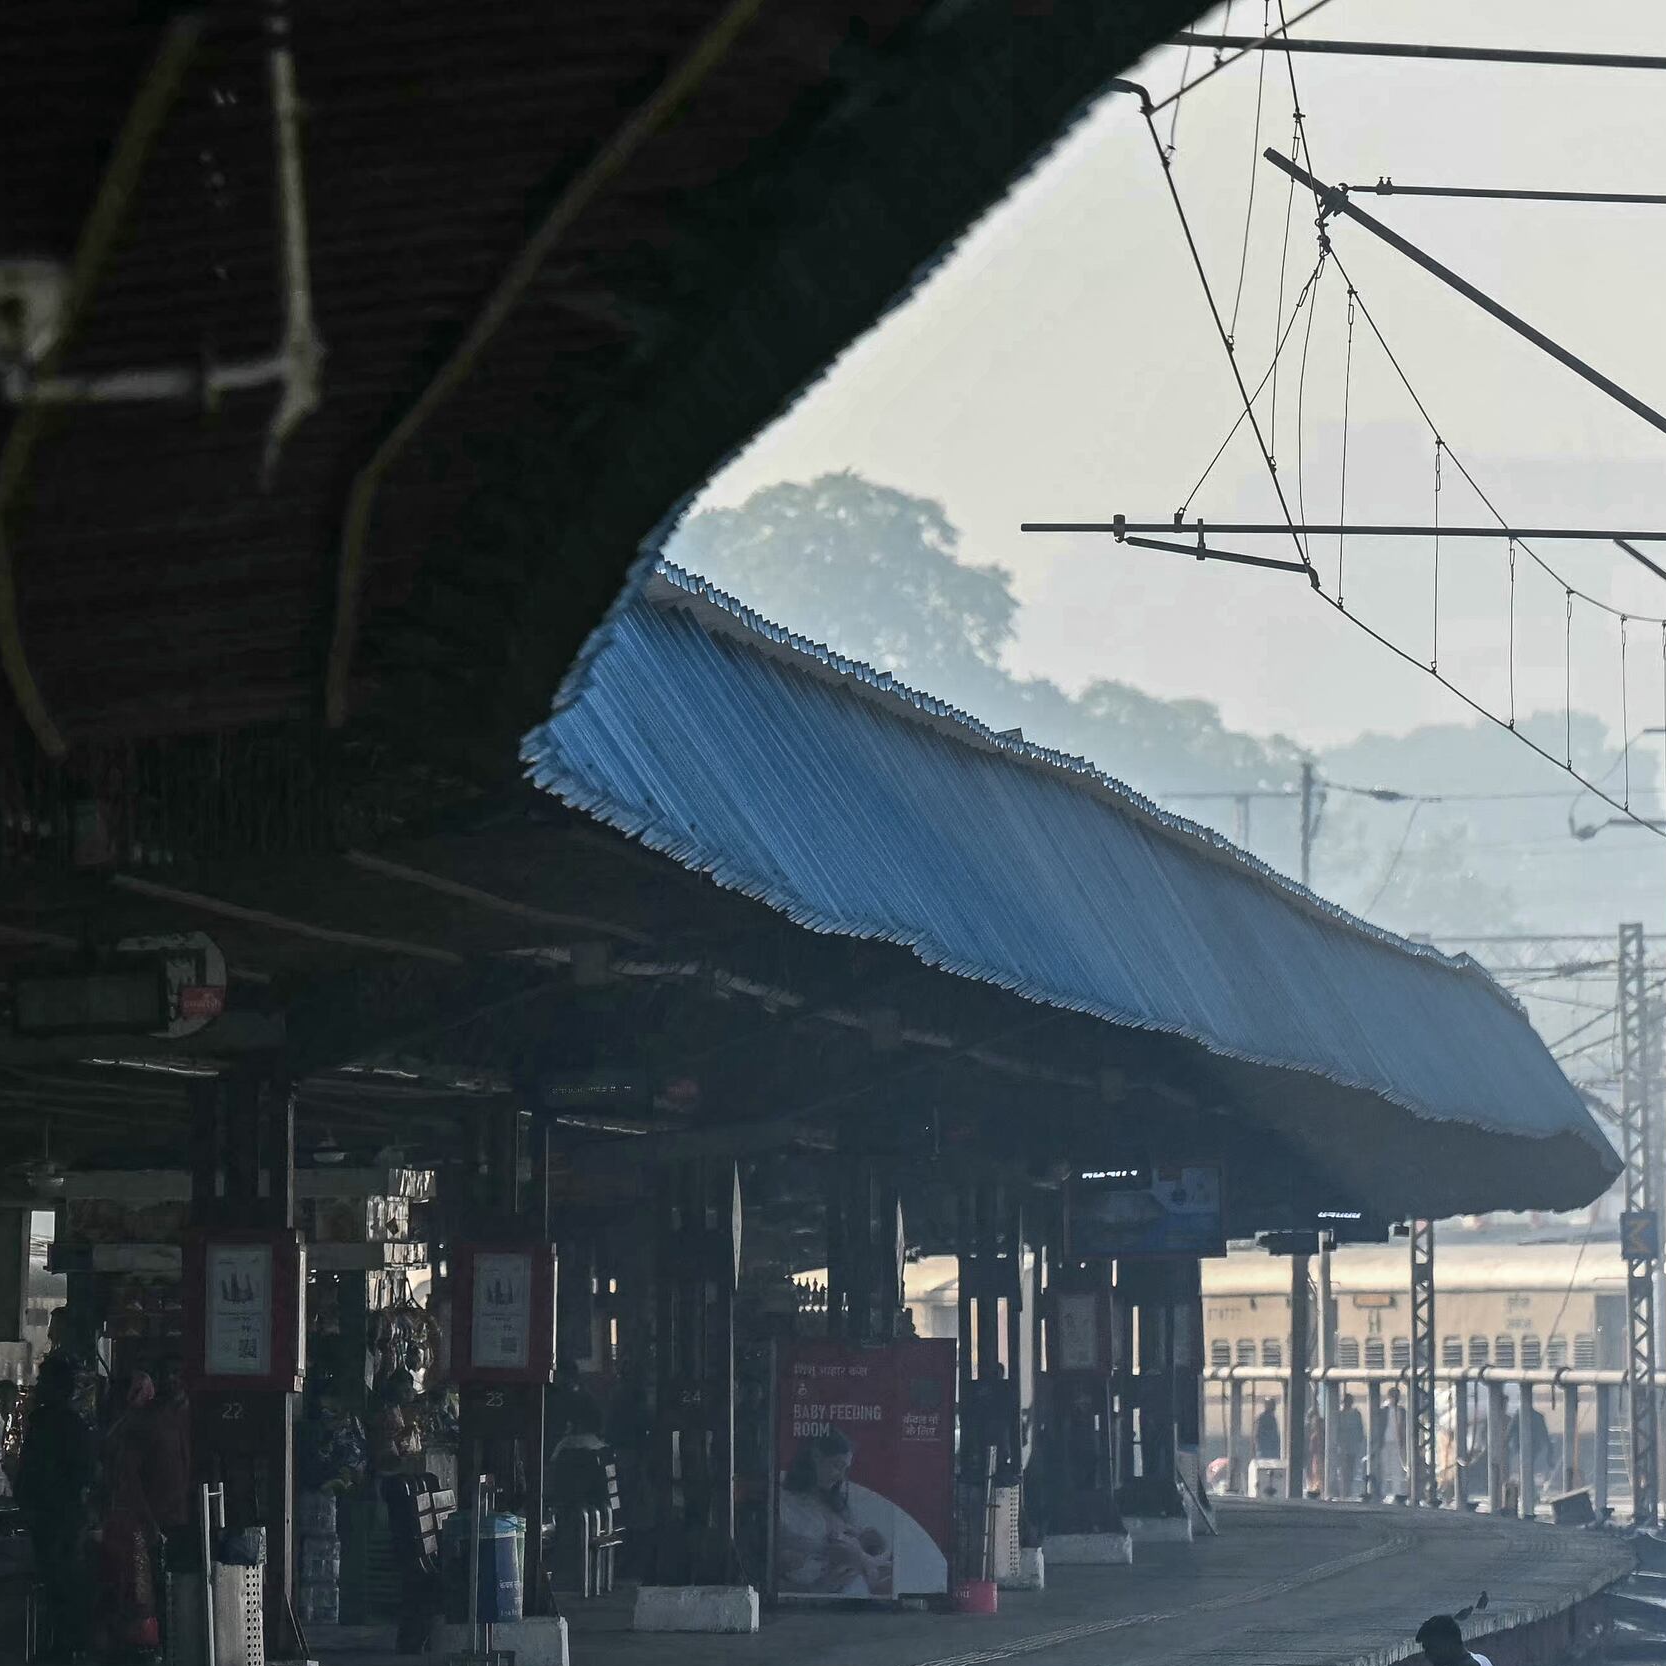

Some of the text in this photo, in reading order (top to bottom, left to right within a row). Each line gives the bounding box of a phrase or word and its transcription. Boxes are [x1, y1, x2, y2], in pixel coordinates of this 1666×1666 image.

[485, 1392, 504, 1407] 23
[222, 1402, 243, 1420] 22
[793, 1404, 882, 1421] BABY FEEDING
[793, 1423, 831, 1438] ROOM
